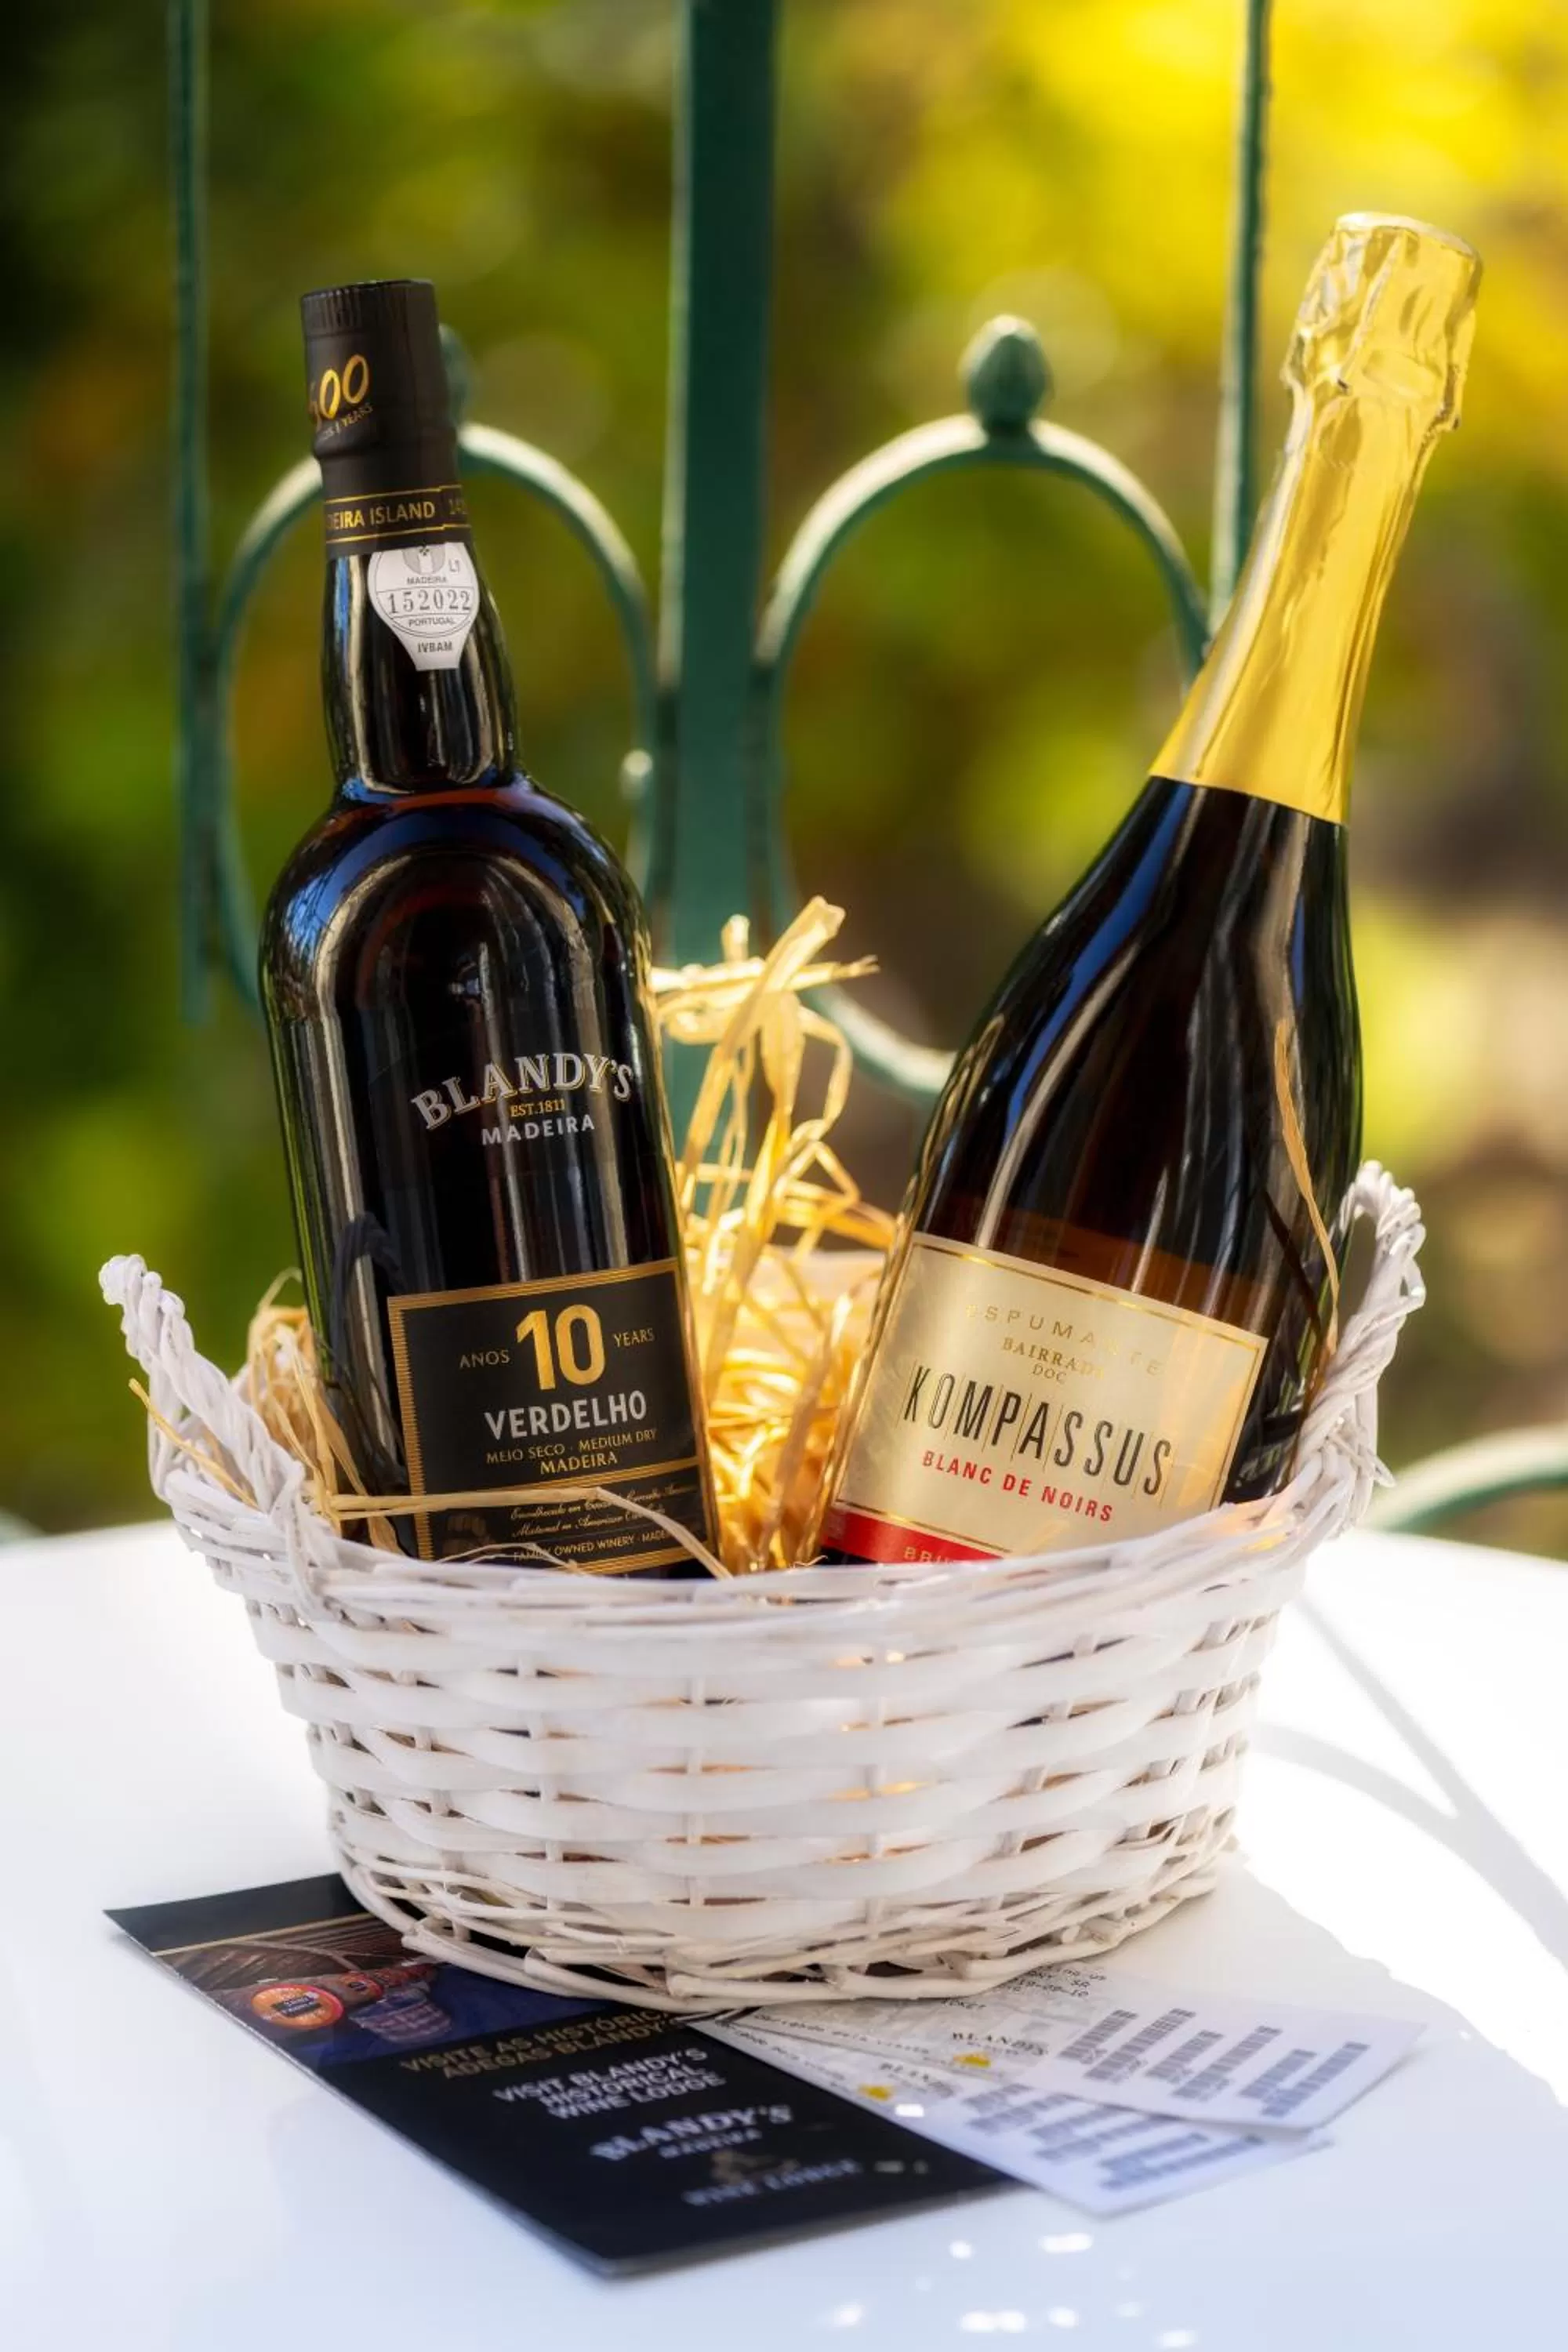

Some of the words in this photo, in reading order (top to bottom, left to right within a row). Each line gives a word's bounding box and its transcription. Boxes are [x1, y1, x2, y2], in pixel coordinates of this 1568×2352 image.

[369, 502, 436, 525] ISLAND
[406, 576, 448, 585] MADEIRA
[387, 589, 471, 615] 152022
[408, 617, 457, 628] PORTUGAL
[417, 641, 453, 653] IVBAM
[411, 1052, 633, 1130] BLANDY'S
[481, 1114, 596, 1145] MADEIRA
[459, 1348, 510, 1369] ANOS
[515, 1304, 605, 1390] 10
[613, 1328, 655, 1348] YEARS
[1031, 1363, 1067, 1385] DOC
[484, 1390, 647, 1440] VERDELHO
[902, 1363, 1173, 1497] KOMPASSUS
[485, 1449, 524, 1465] MEIO
[528, 1442, 565, 1460] SECO
[579, 1435, 633, 1453] MEDIUM
[636, 1428, 657, 1443] DRY
[539, 1451, 619, 1475] MADEIRA
[921, 1450, 994, 1485] BLANC
[1003, 1472, 1032, 1497] DE
[1040, 1484, 1114, 1523] NOIRS
[554, 1542, 594, 1555] OWNED
[597, 1533, 635, 1549] WINERY
[642, 1529, 666, 1542] MADE
[492, 2077, 567, 2102] VISIT
[568, 2046, 708, 2086] BLANDY'S
